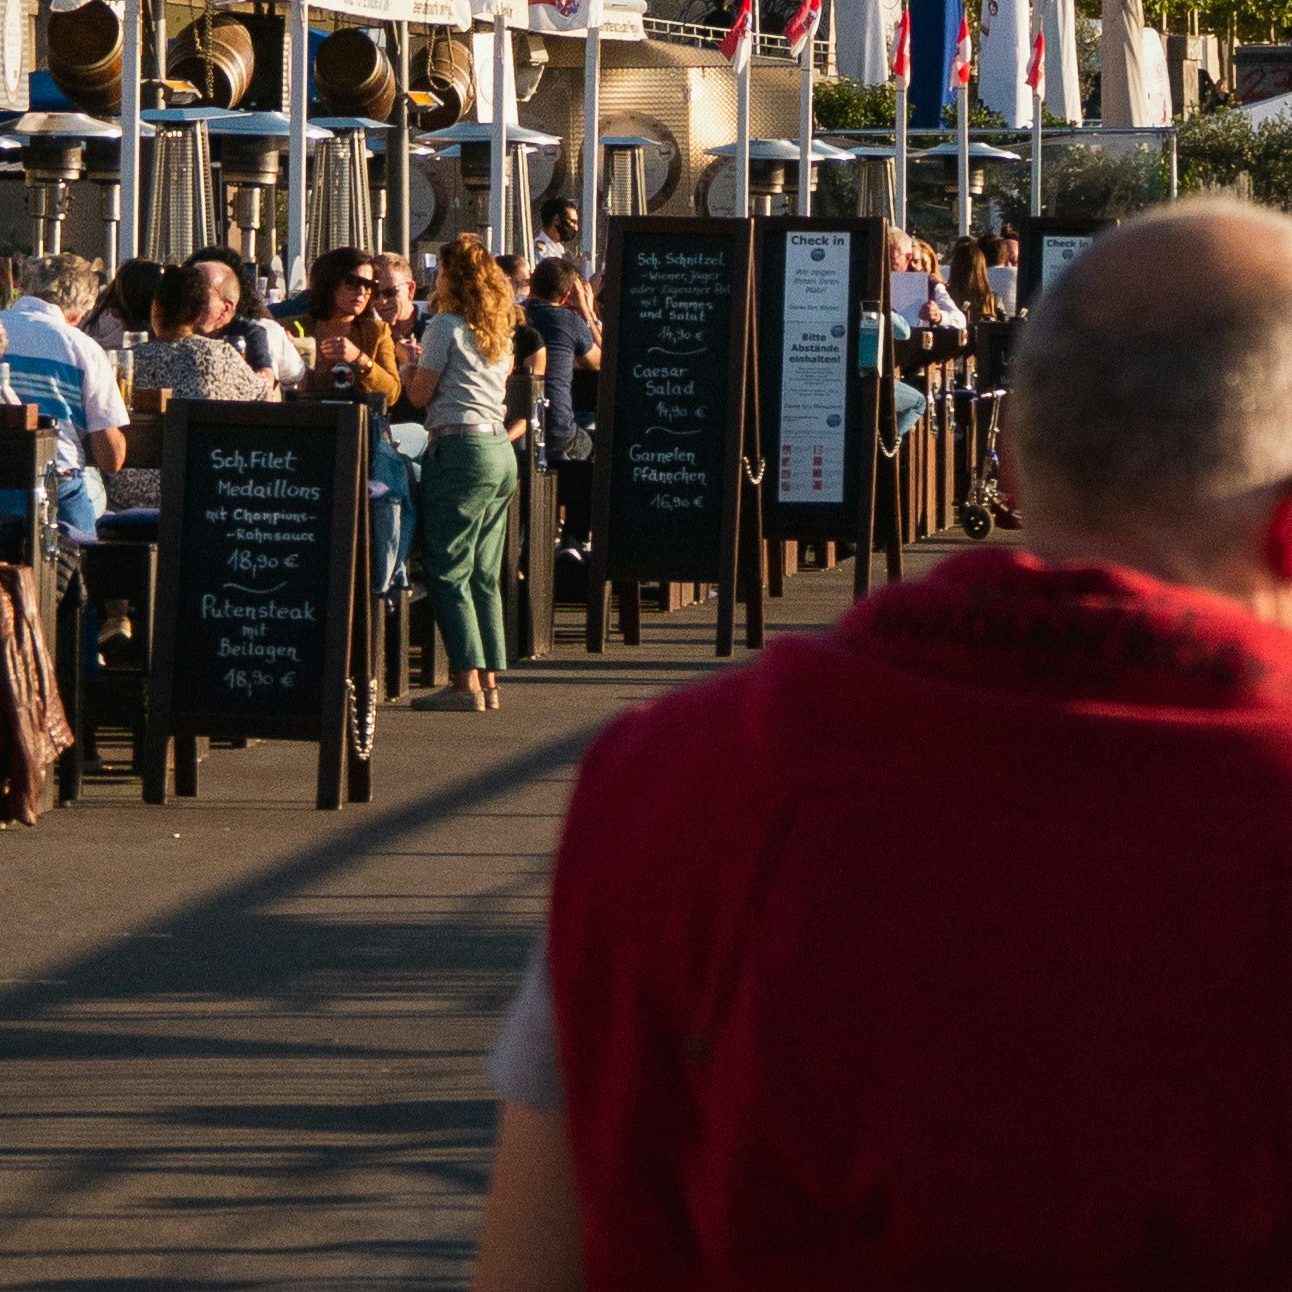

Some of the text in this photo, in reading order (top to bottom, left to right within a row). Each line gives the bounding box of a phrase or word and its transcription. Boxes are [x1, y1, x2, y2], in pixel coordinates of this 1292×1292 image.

[791, 234, 845, 246] Check in
[665, 251, 726, 269] Schnitzel
[639, 309, 706, 322] und Salat
[802, 333, 827, 342] Bitte
[633, 363, 689, 378] Caesar
[645, 379, 695, 396] Salad
[629, 443, 696, 464] Garnelen
[632, 466, 708, 486] Pfännchen
[217, 478, 321, 501] Medaillons
[282, 552, 300, 569] €
[201, 593, 316, 622] Putensteak
[240, 622, 269, 640] mit
[217, 637, 301, 664] Beilagen
[280, 671, 296, 688] €
